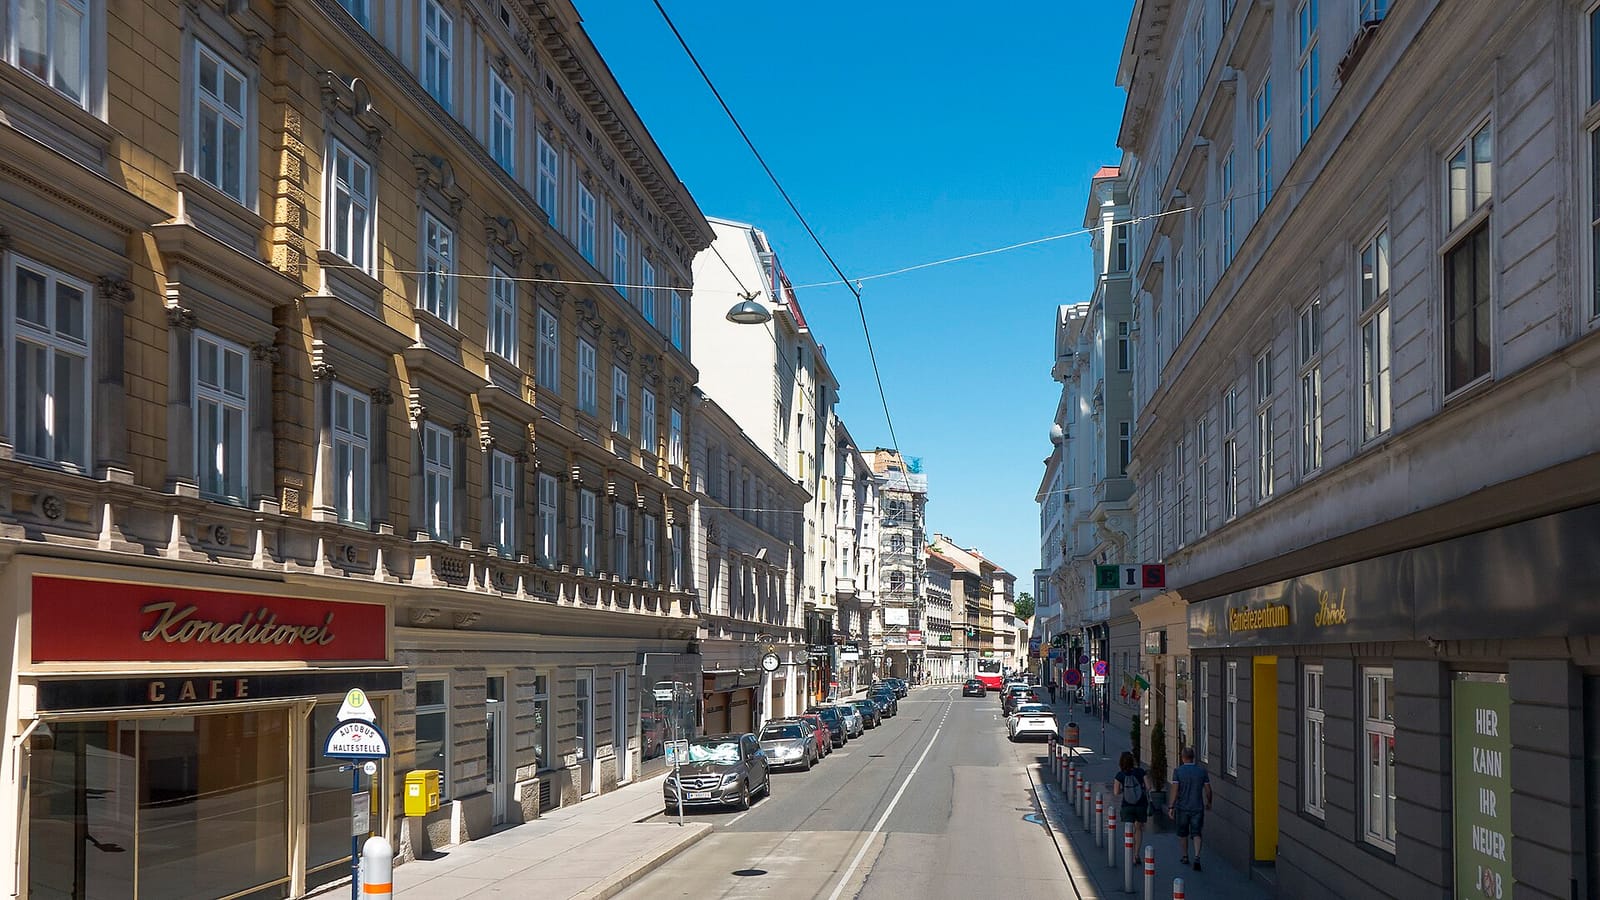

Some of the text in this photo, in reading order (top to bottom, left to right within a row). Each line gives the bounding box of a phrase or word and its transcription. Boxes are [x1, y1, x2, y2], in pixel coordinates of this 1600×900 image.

[1101, 567, 1161, 585] EIS
[1229, 602, 1289, 632] Karrierezentrum
[1314, 587, 1348, 627] Ströck
[141, 602, 335, 645] Konditorei
[149, 678, 249, 702] CAFE
[339, 724, 376, 739] AUTOBUS
[1475, 707, 1499, 737] HIER
[332, 744, 381, 753] HALTESTELLE
[1472, 746, 1503, 778] KANN
[1479, 787, 1497, 818] IHR
[1472, 824, 1506, 862] NEUER
